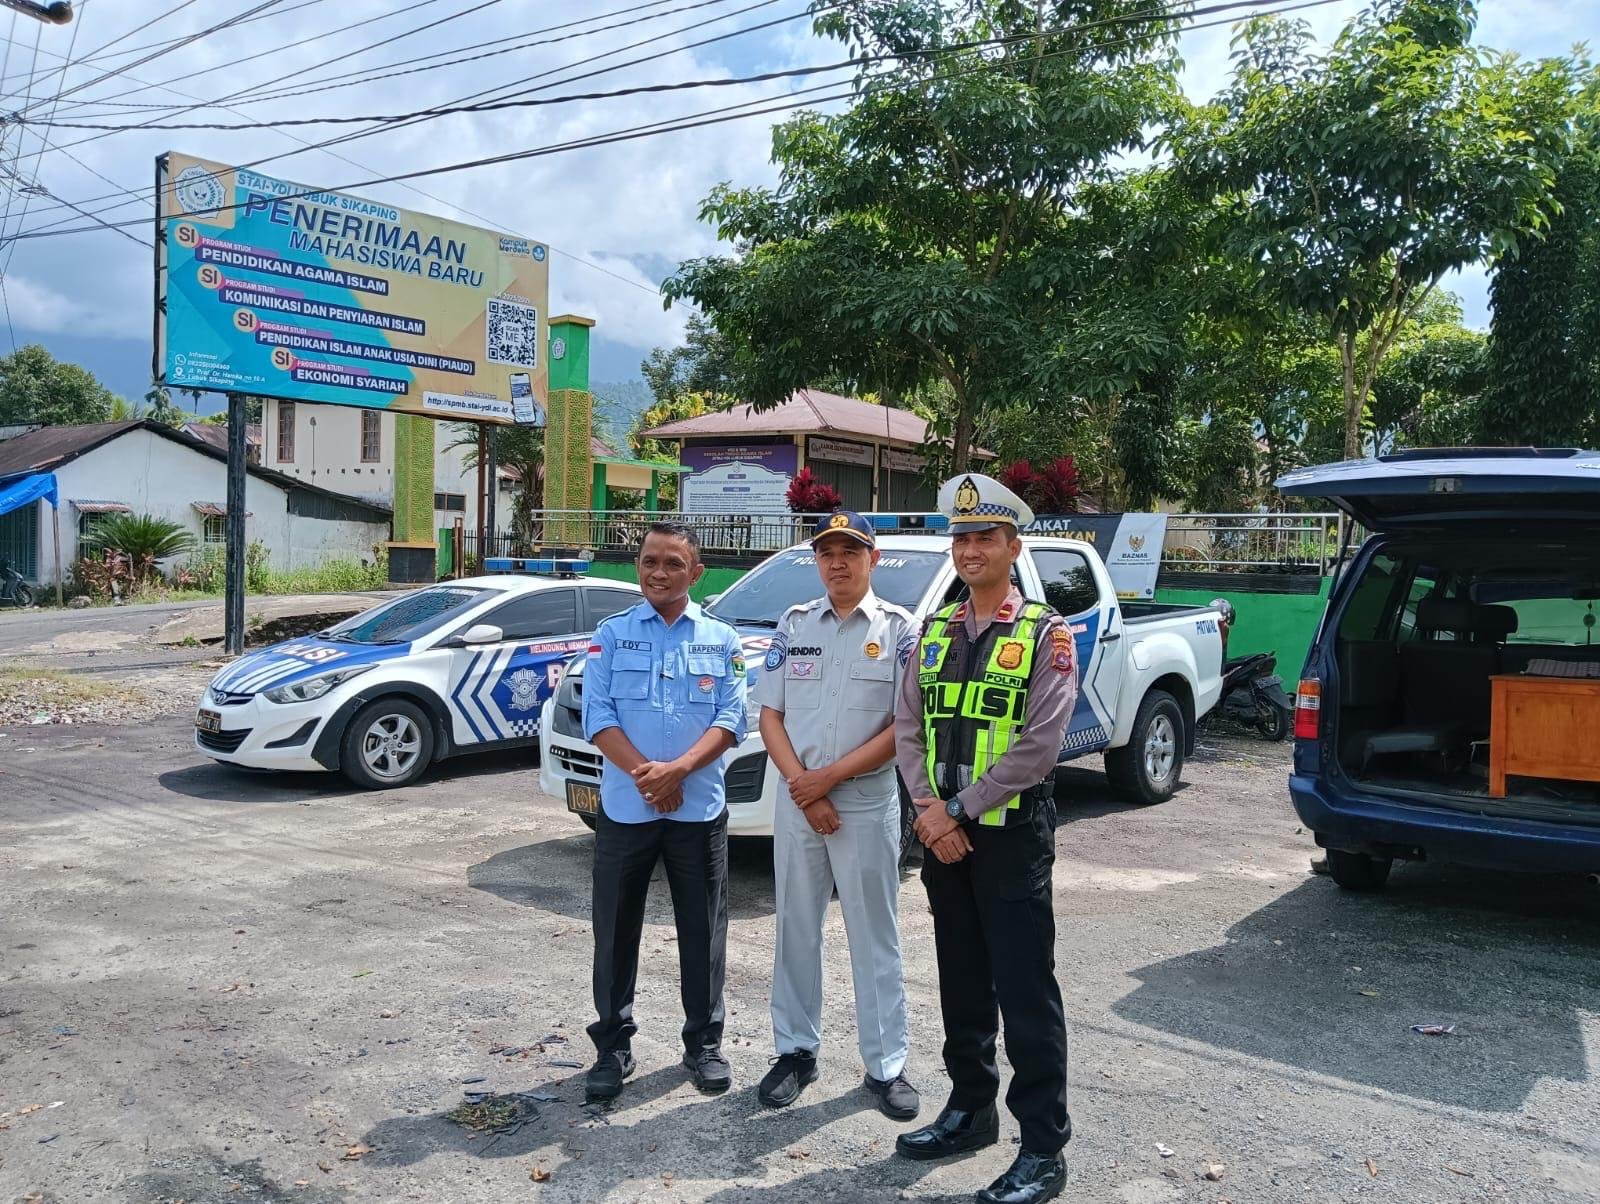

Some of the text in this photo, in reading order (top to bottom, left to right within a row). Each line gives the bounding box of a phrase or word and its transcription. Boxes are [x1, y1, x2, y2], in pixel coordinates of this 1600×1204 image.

[238, 173, 290, 195] STAI-YDI
[294, 187, 338, 207] LUBUK
[341, 199, 398, 221] SIKAPING
[244, 192, 466, 264] PENERIMAAN
[201, 237, 251, 252] PROGRAM STUDI
[499, 237, 528, 247] Kampus
[289, 230, 484, 287] MAHASISWA BARU
[202, 248, 386, 293] PENDIDIKAN AGAMA ISLAM
[225, 279, 276, 294] PROGRAM STUDI
[225, 290, 423, 334] KOMUNIKASI DAN PENYIARAN ISLAM
[260, 322, 307, 335] PROGRAM STUDI
[505, 331, 520, 343] ME
[188, 351, 218, 360] Informasi
[260, 331, 473, 374] PENDIDIKAN ISLAM ANAK USIA DINI (PIAUD)
[297, 360, 344, 372] PROGRAM STUDI
[297, 369, 406, 393] EKONOMI SYARIAH
[1022, 519, 1072, 532] ZAKAT
[622, 640, 640, 650] EDY
[691, 645, 725, 653] BAPENDA
[787, 646, 823, 657] HENDRO
[986, 673, 1021, 687] POLRI
[921, 684, 1026, 722] OLISI
